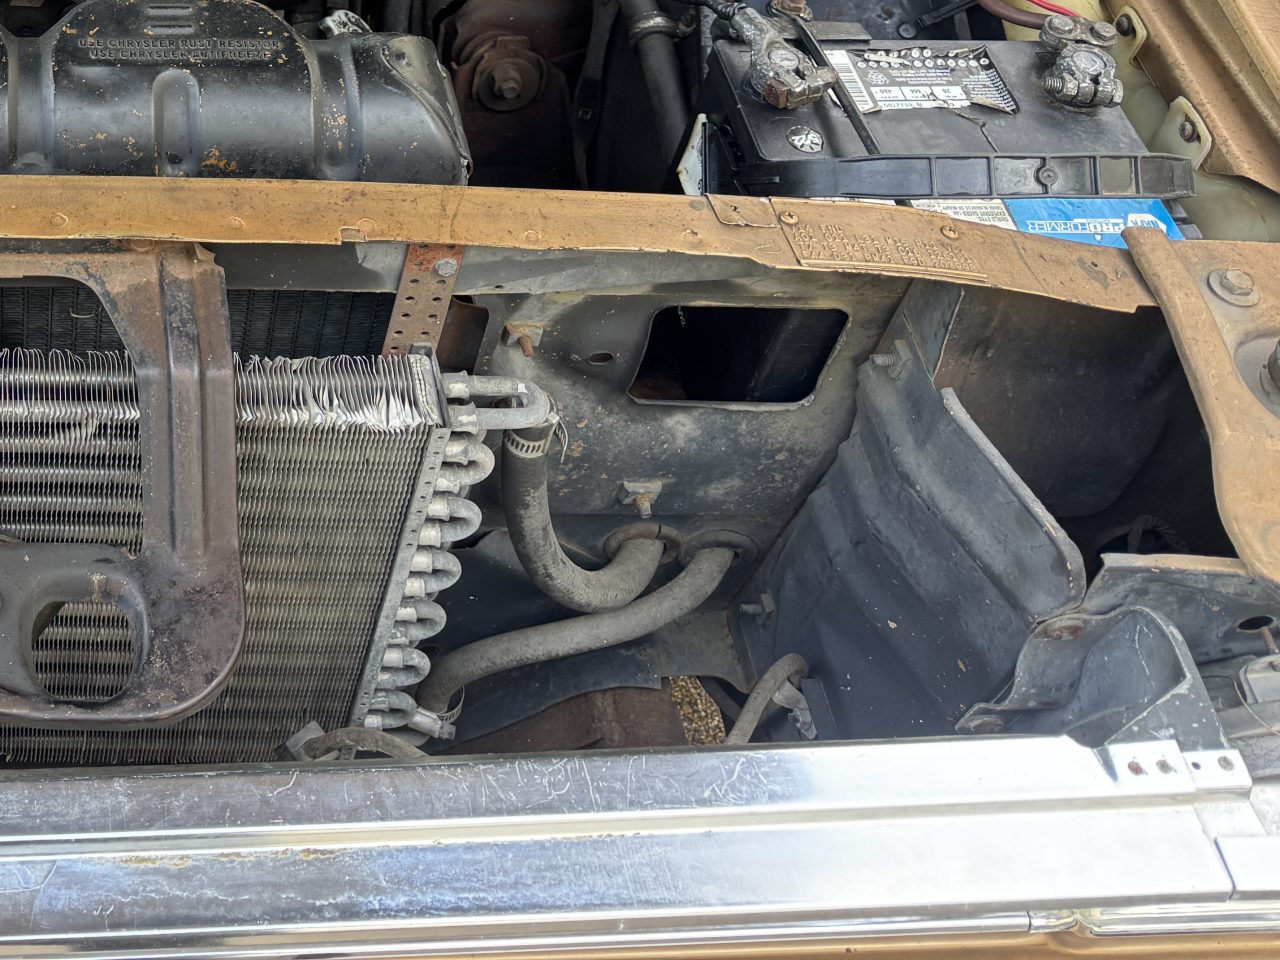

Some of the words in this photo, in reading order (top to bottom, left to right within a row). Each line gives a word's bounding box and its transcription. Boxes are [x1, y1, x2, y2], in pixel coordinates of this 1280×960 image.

[77, 39, 104, 49] USE
[108, 39, 174, 49] CHRYSLER
[179, 39, 213, 49] RUST
[218, 39, 281, 49] RESISTOR
[89, 49, 116, 59] USE
[120, 49, 188, 60] CHRYSLER
[192, 49, 272, 61] ANTIFREEZE
[1028, 221, 1125, 232] PROFORMER
